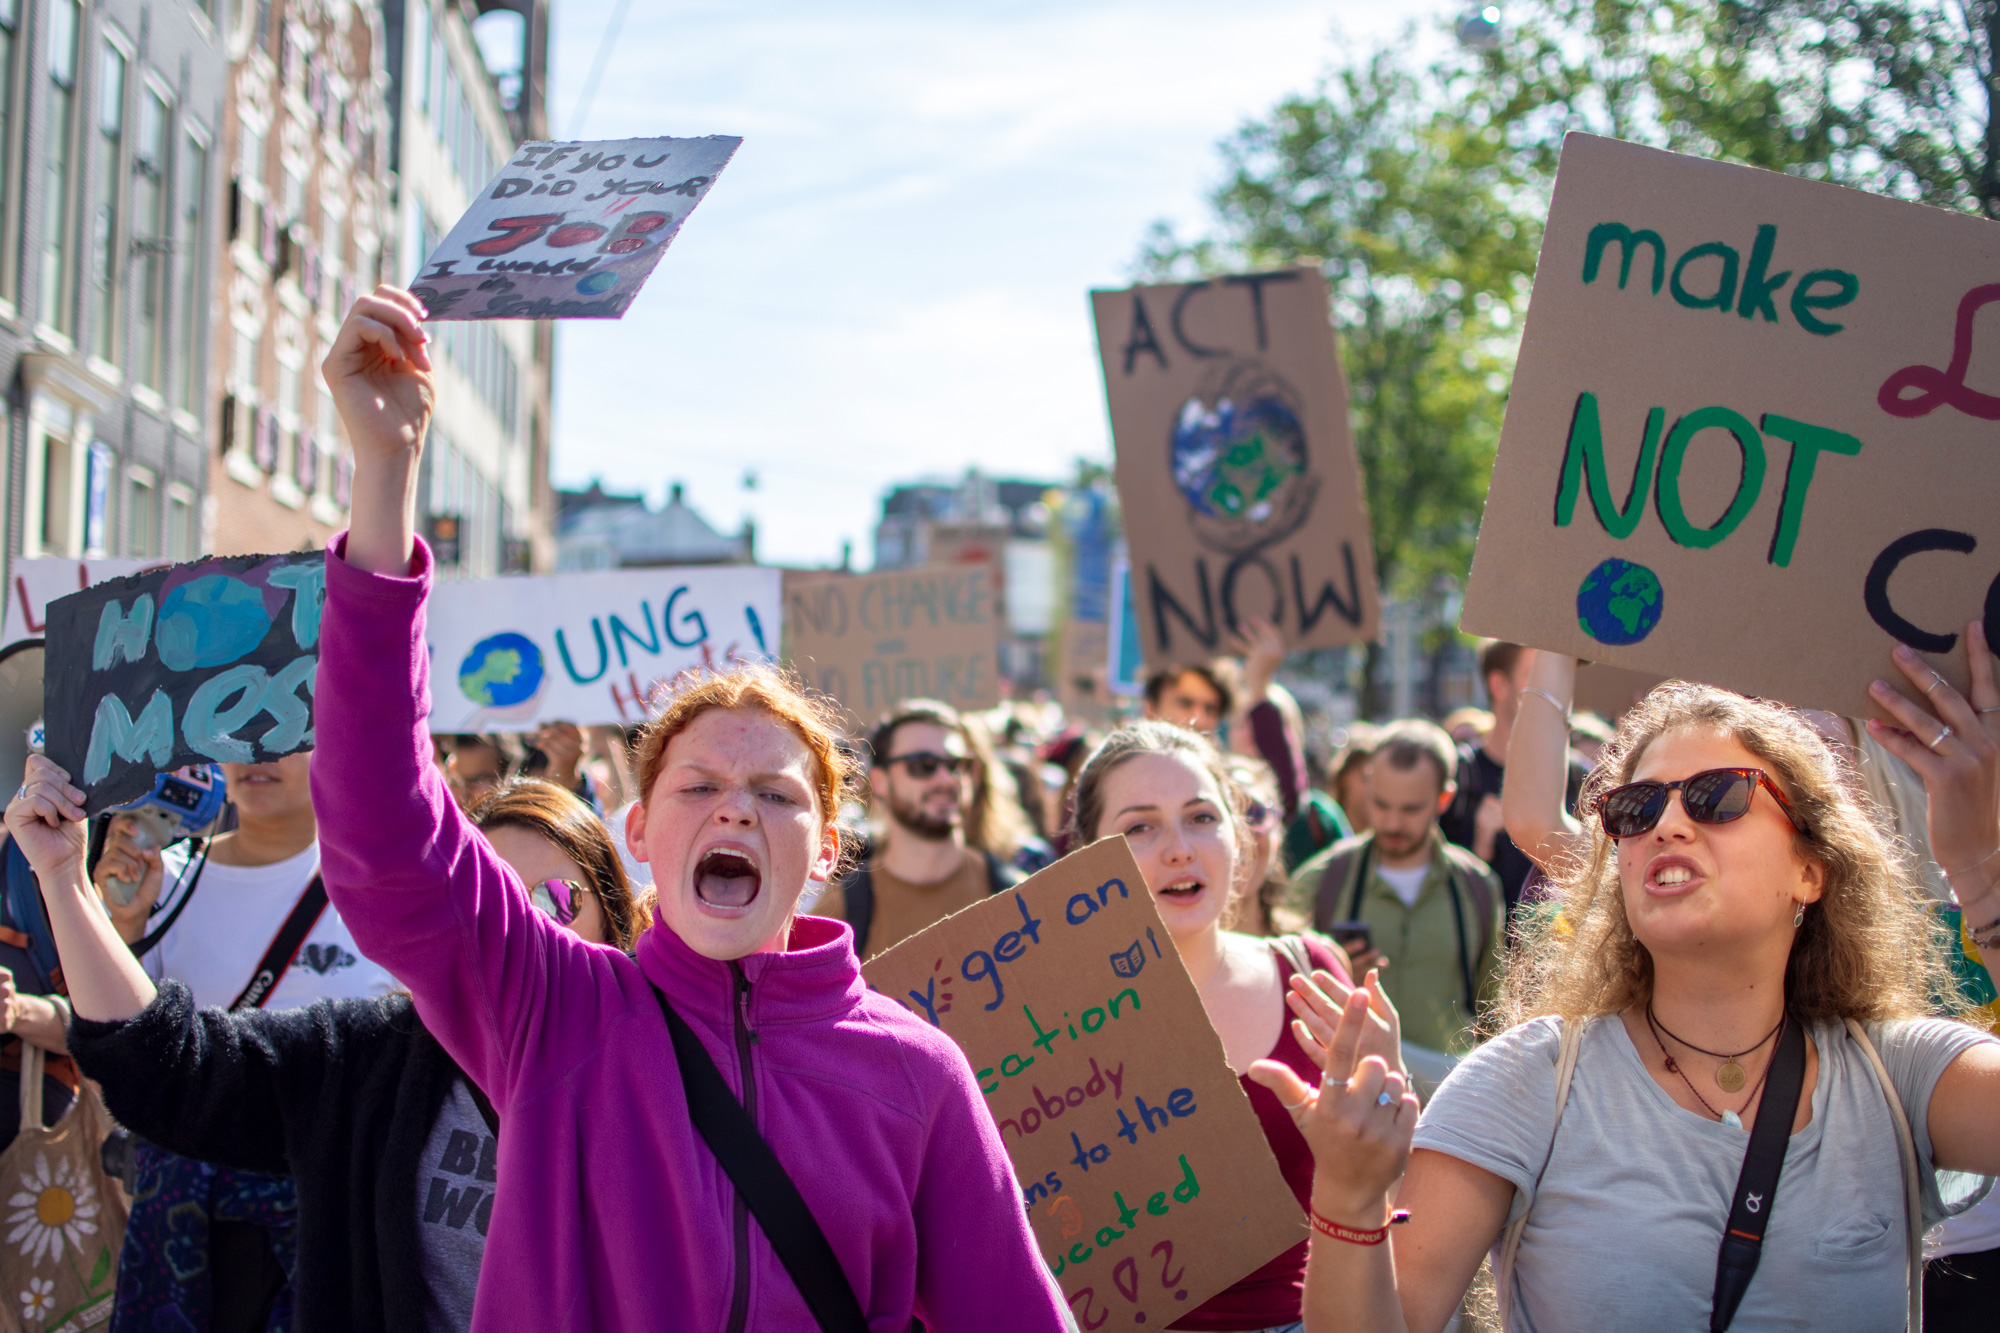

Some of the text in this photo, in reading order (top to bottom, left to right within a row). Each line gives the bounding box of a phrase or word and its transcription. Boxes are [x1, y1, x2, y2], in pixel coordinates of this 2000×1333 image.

[421, 259, 460, 281] I
[465, 210, 674, 257] JOB
[1580, 221, 1860, 337] make
[1122, 270, 1300, 376] ACT
[1552, 390, 1865, 568] NOT
[791, 570, 988, 637] NO CHANGE
[1146, 540, 1363, 652] NOW
[1863, 528, 2000, 660] C
[861, 653, 988, 709] FUTURE
[961, 893, 1042, 1012] get
[1065, 878, 1130, 926] an
[999, 1057, 1124, 1138] nobody
[1070, 1131, 1112, 1173] to
[1117, 1087, 1198, 1145] the
[1337, 1228, 1382, 1242] FREUNDE
